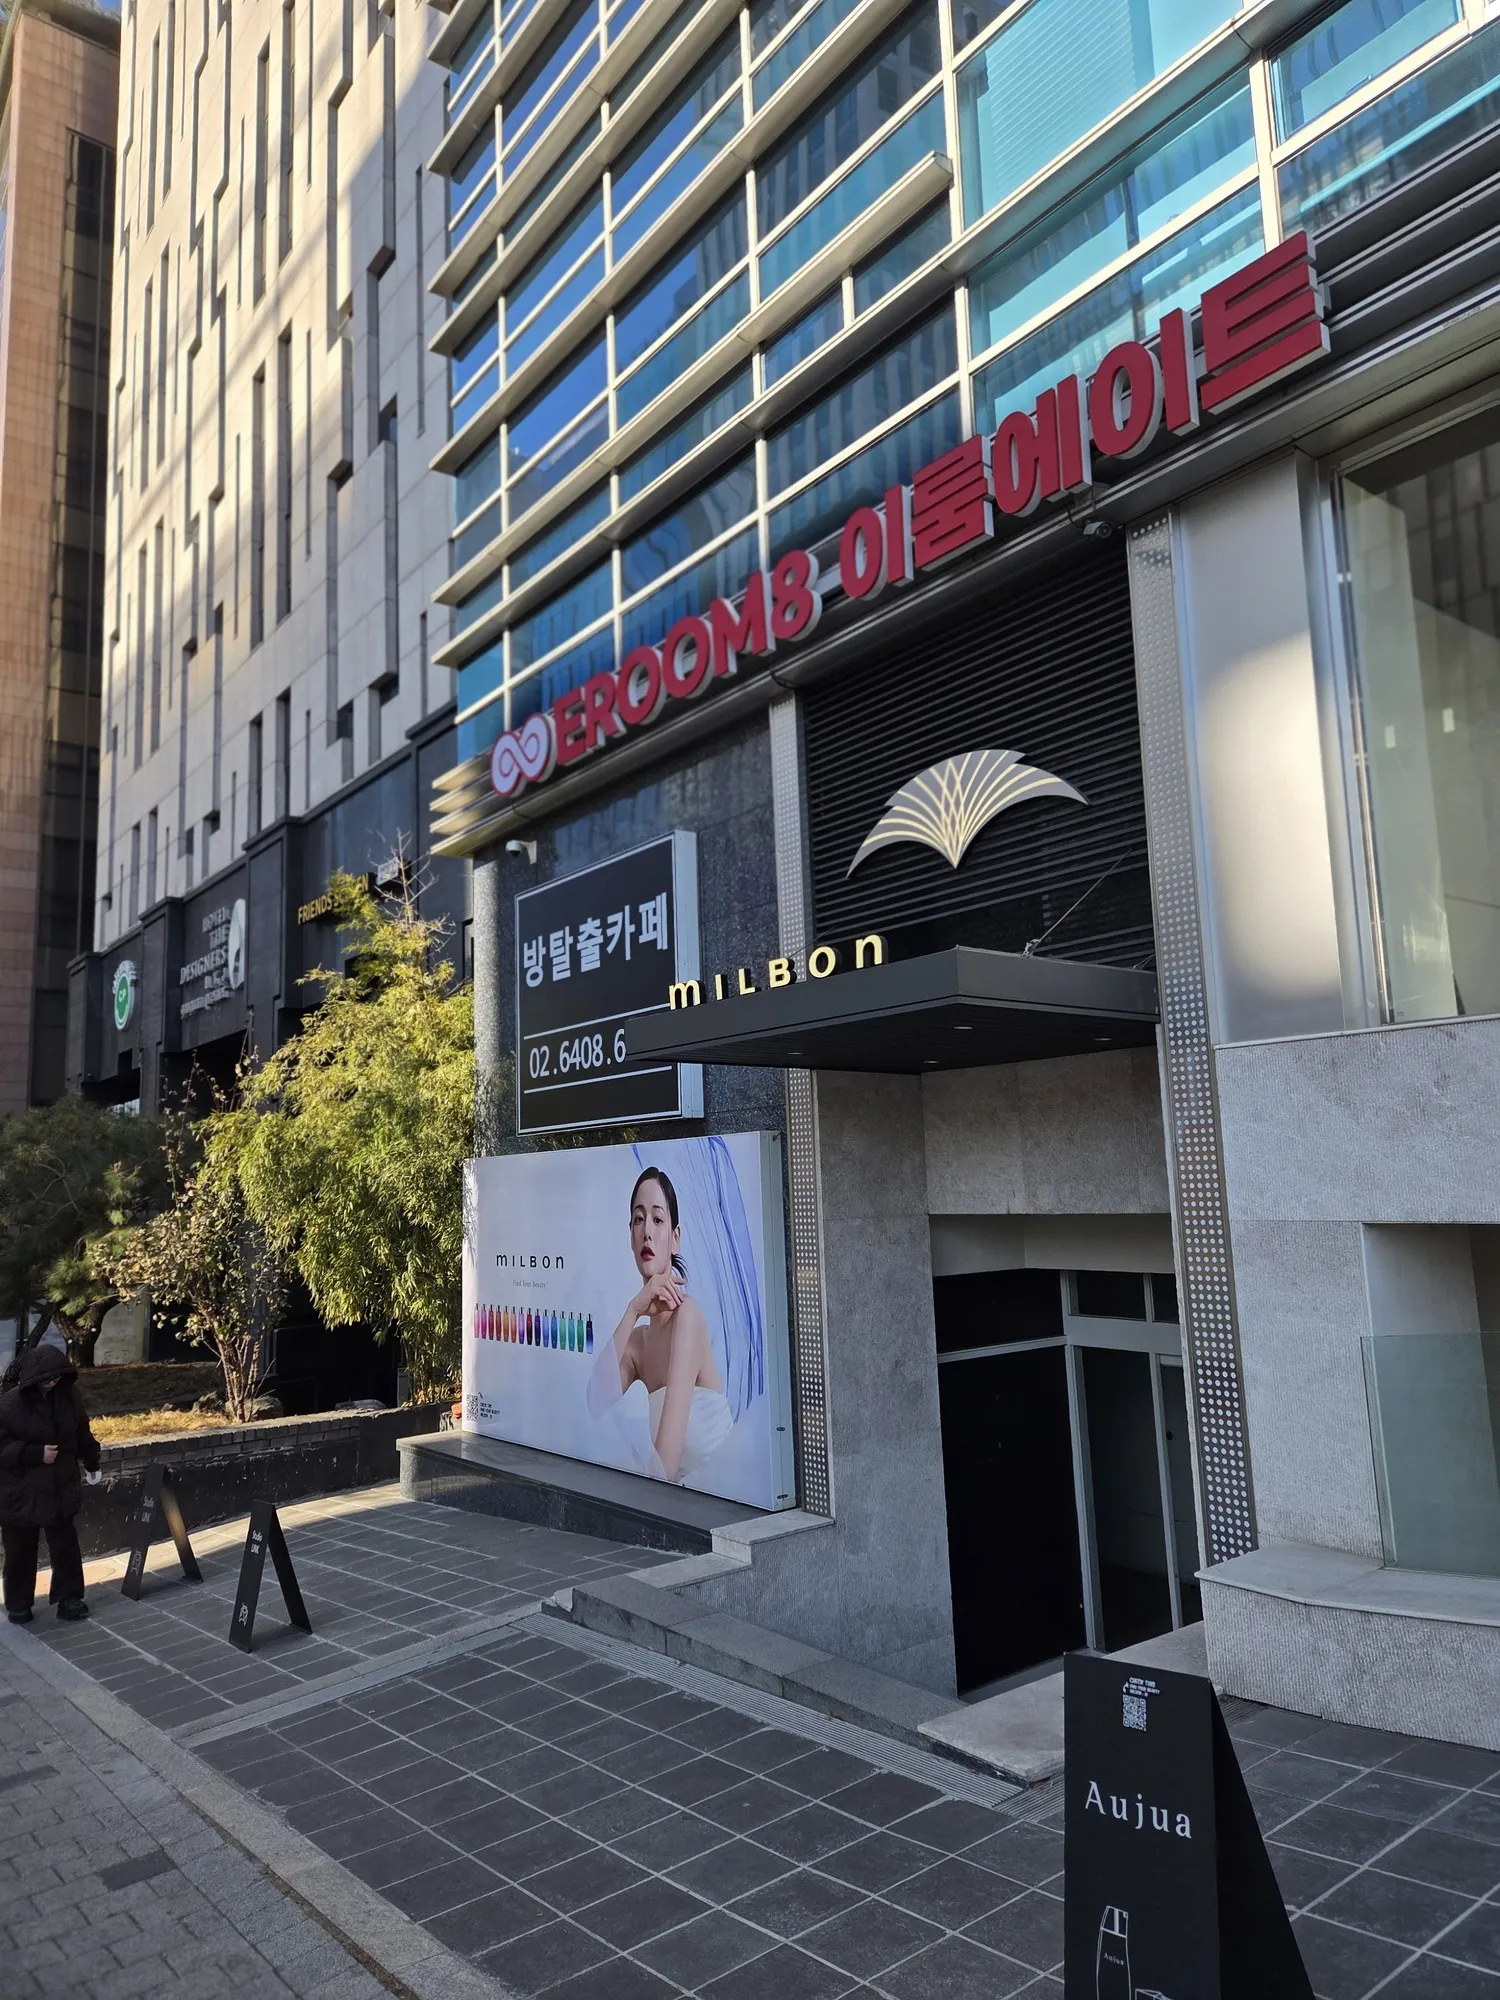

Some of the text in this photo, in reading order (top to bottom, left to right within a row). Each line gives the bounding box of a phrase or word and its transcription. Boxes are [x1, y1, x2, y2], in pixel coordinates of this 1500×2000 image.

[553, 230, 1332, 766] EROOM8 이룸에이트
[297, 892, 333, 925] FRIENDS
[522, 891, 670, 989] 방탈출카페
[179, 945, 229, 985] DESIGNERS
[1085, 1780, 1192, 1839] Aujua
[1103, 1952, 1125, 1966] Aujua
